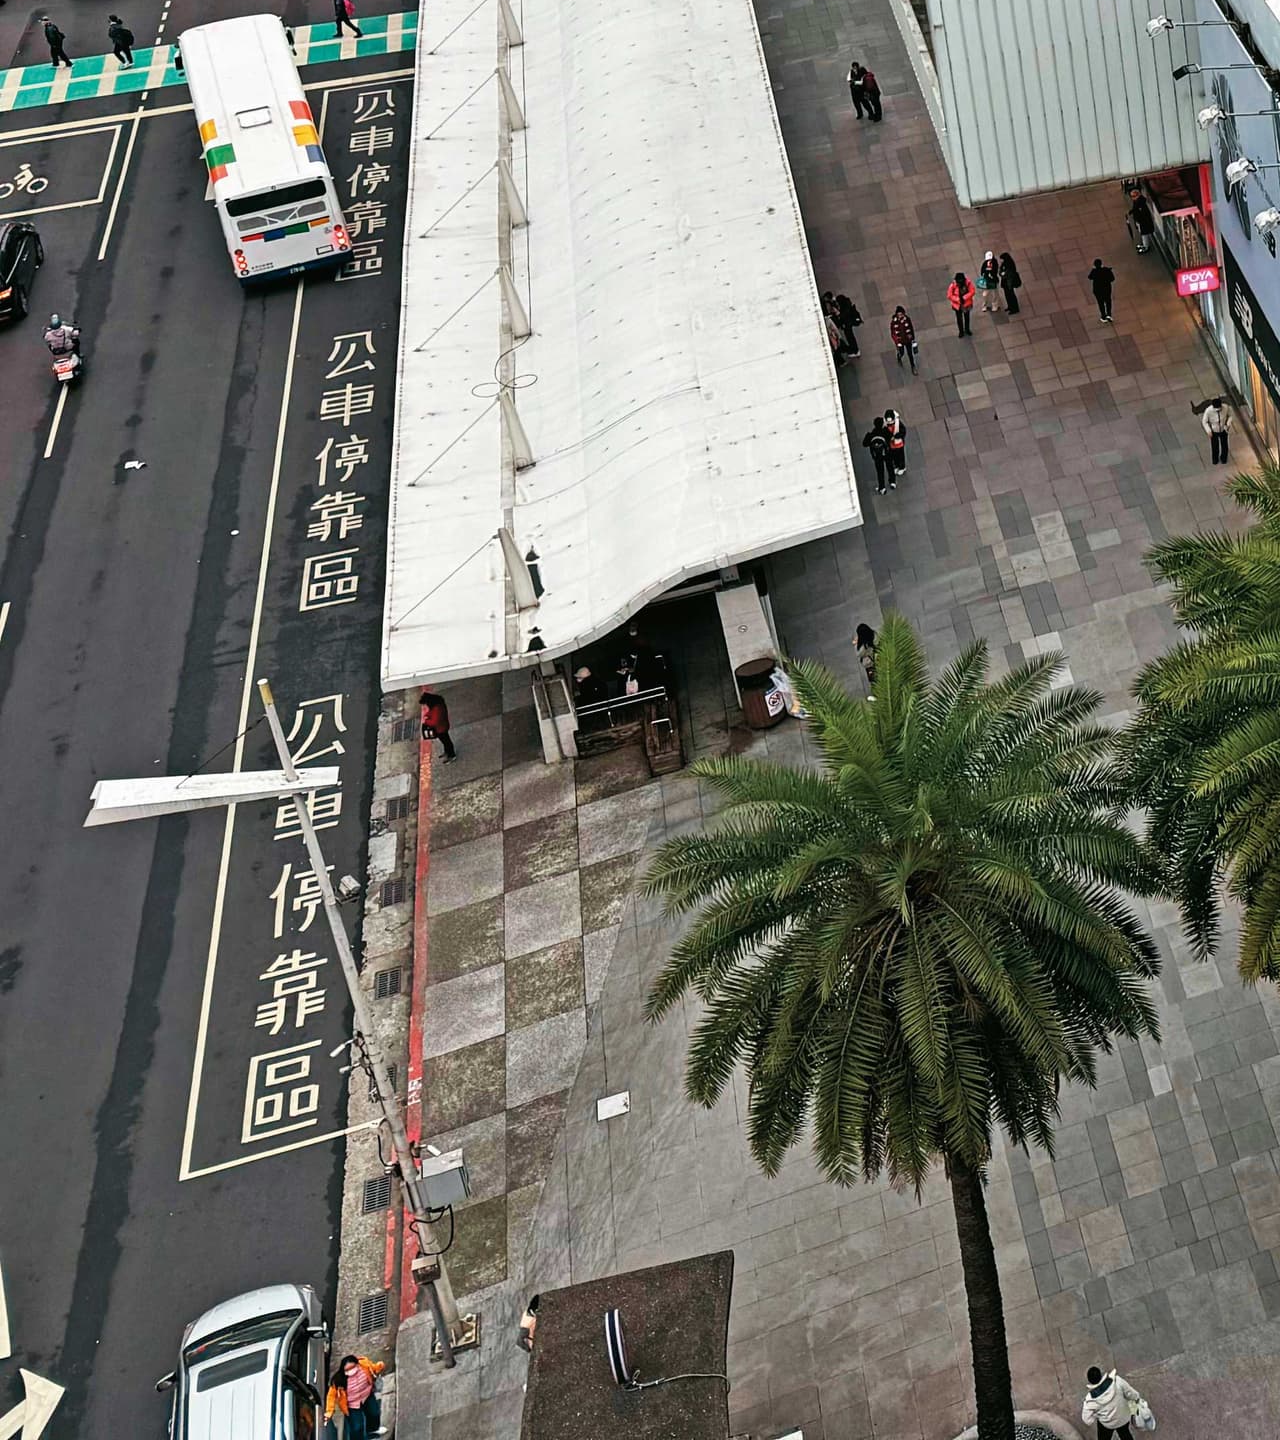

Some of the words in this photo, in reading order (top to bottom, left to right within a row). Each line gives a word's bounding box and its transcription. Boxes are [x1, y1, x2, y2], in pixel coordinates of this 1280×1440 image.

[336, 90, 396, 281] 公車停靠區
[1181, 270, 1214, 284] POYA
[299, 331, 379, 613] 公車停靠區
[241, 693, 347, 1143] 公車停靠區
